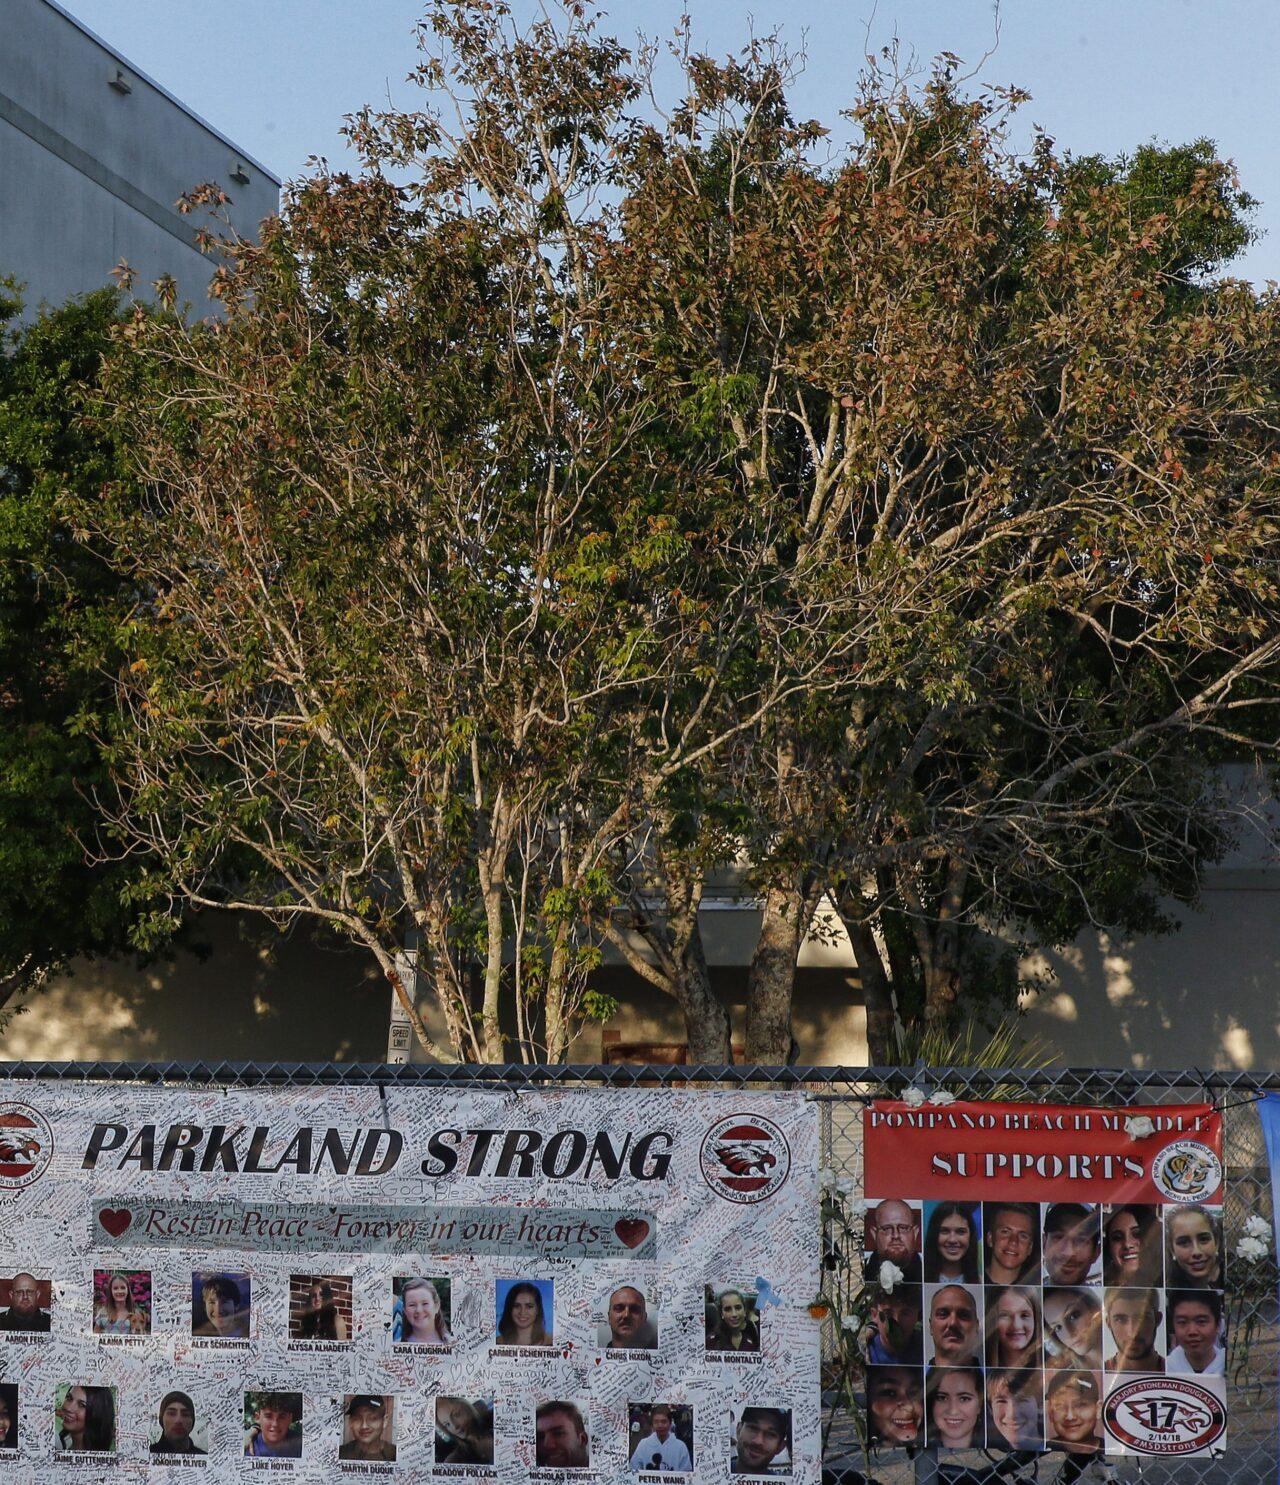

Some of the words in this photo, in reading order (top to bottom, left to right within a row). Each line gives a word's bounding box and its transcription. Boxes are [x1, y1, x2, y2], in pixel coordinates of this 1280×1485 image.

[392, 1029, 409, 1038] SPEED
[393, 1039, 407, 1047] LIMIT
[870, 1110, 997, 1129] POMPANO
[1003, 1113, 1092, 1131] BEACH
[1101, 1113, 1212, 1133] MDLE
[709, 1120, 736, 1141] POSITIVE
[761, 1122, 788, 1157] PASSIONATE
[81, 1123, 404, 1176] PARKLAND
[421, 1128, 674, 1181] STRONG
[1166, 1142, 1189, 1153] BEACH
[1190, 1142, 1212, 1156] MIDDLE
[931, 1152, 1146, 1180] SUPPORTS
[1164, 1189, 1191, 1202] BENGAL
[1192, 1190, 1210, 1201] PRIDE
[145, 1208, 201, 1236] Rest
[209, 1209, 234, 1236] in
[240, 1210, 309, 1238] Peace
[333, 1212, 417, 1240] Forever
[429, 1215, 455, 1240] in
[462, 1221, 510, 1241] our
[517, 1214, 601, 1243] hearts
[5, 1334, 28, 1344] AARON
[28, 1335, 44, 1344] FEIS
[124, 1338, 146, 1347] PETTY
[191, 1340, 209, 1349] ALEX
[210, 1340, 250, 1350] SCHACHTER
[287, 1342, 312, 1352] ALYSSA
[313, 1343, 350, 1352] ALHADEFF
[393, 1345, 413, 1355] CARA
[414, 1346, 452, 1356] LOUGHRAN
[488, 1348, 518, 1358] CARMEN
[519, 1349, 562, 1359] SCHENTRUP
[605, 1351, 627, 1360] CHRIS
[628, 1352, 651, 1361] NIXON
[704, 1353, 723, 1363] GINA
[724, 1354, 762, 1365] MONTALTO
[1109, 1384, 1138, 1409] MARJORY
[1138, 1381, 1179, 1391] STONEMAN
[1179, 1382, 1211, 1405] DOUGLAS
[1146, 1401, 1179, 1429] 17
[1148, 1433, 1181, 1442] 2/14/18
[1133, 1438, 1198, 1452] #MSDStrong
[53, 1453, 74, 1463] JAIME
[74, 1454, 120, 1465] GUTTENBERG
[151, 1458, 182, 1468] JOAQUIN
[182, 1459, 207, 1468] OLIVER
[251, 1462, 269, 1471] LUKE
[270, 1462, 293, 1471] HOYER
[341, 1465, 369, 1474] MARTIN
[370, 1465, 394, 1475] DUQUE
[432, 1468, 465, 1477] MEADOW
[466, 1469, 498, 1478] POLLACK
[529, 1471, 565, 1481] NICHOLAS
[566, 1472, 597, 1481] DWORET
[639, 1475, 662, 1484] PETER
[662, 1475, 686, 1485] WANG
